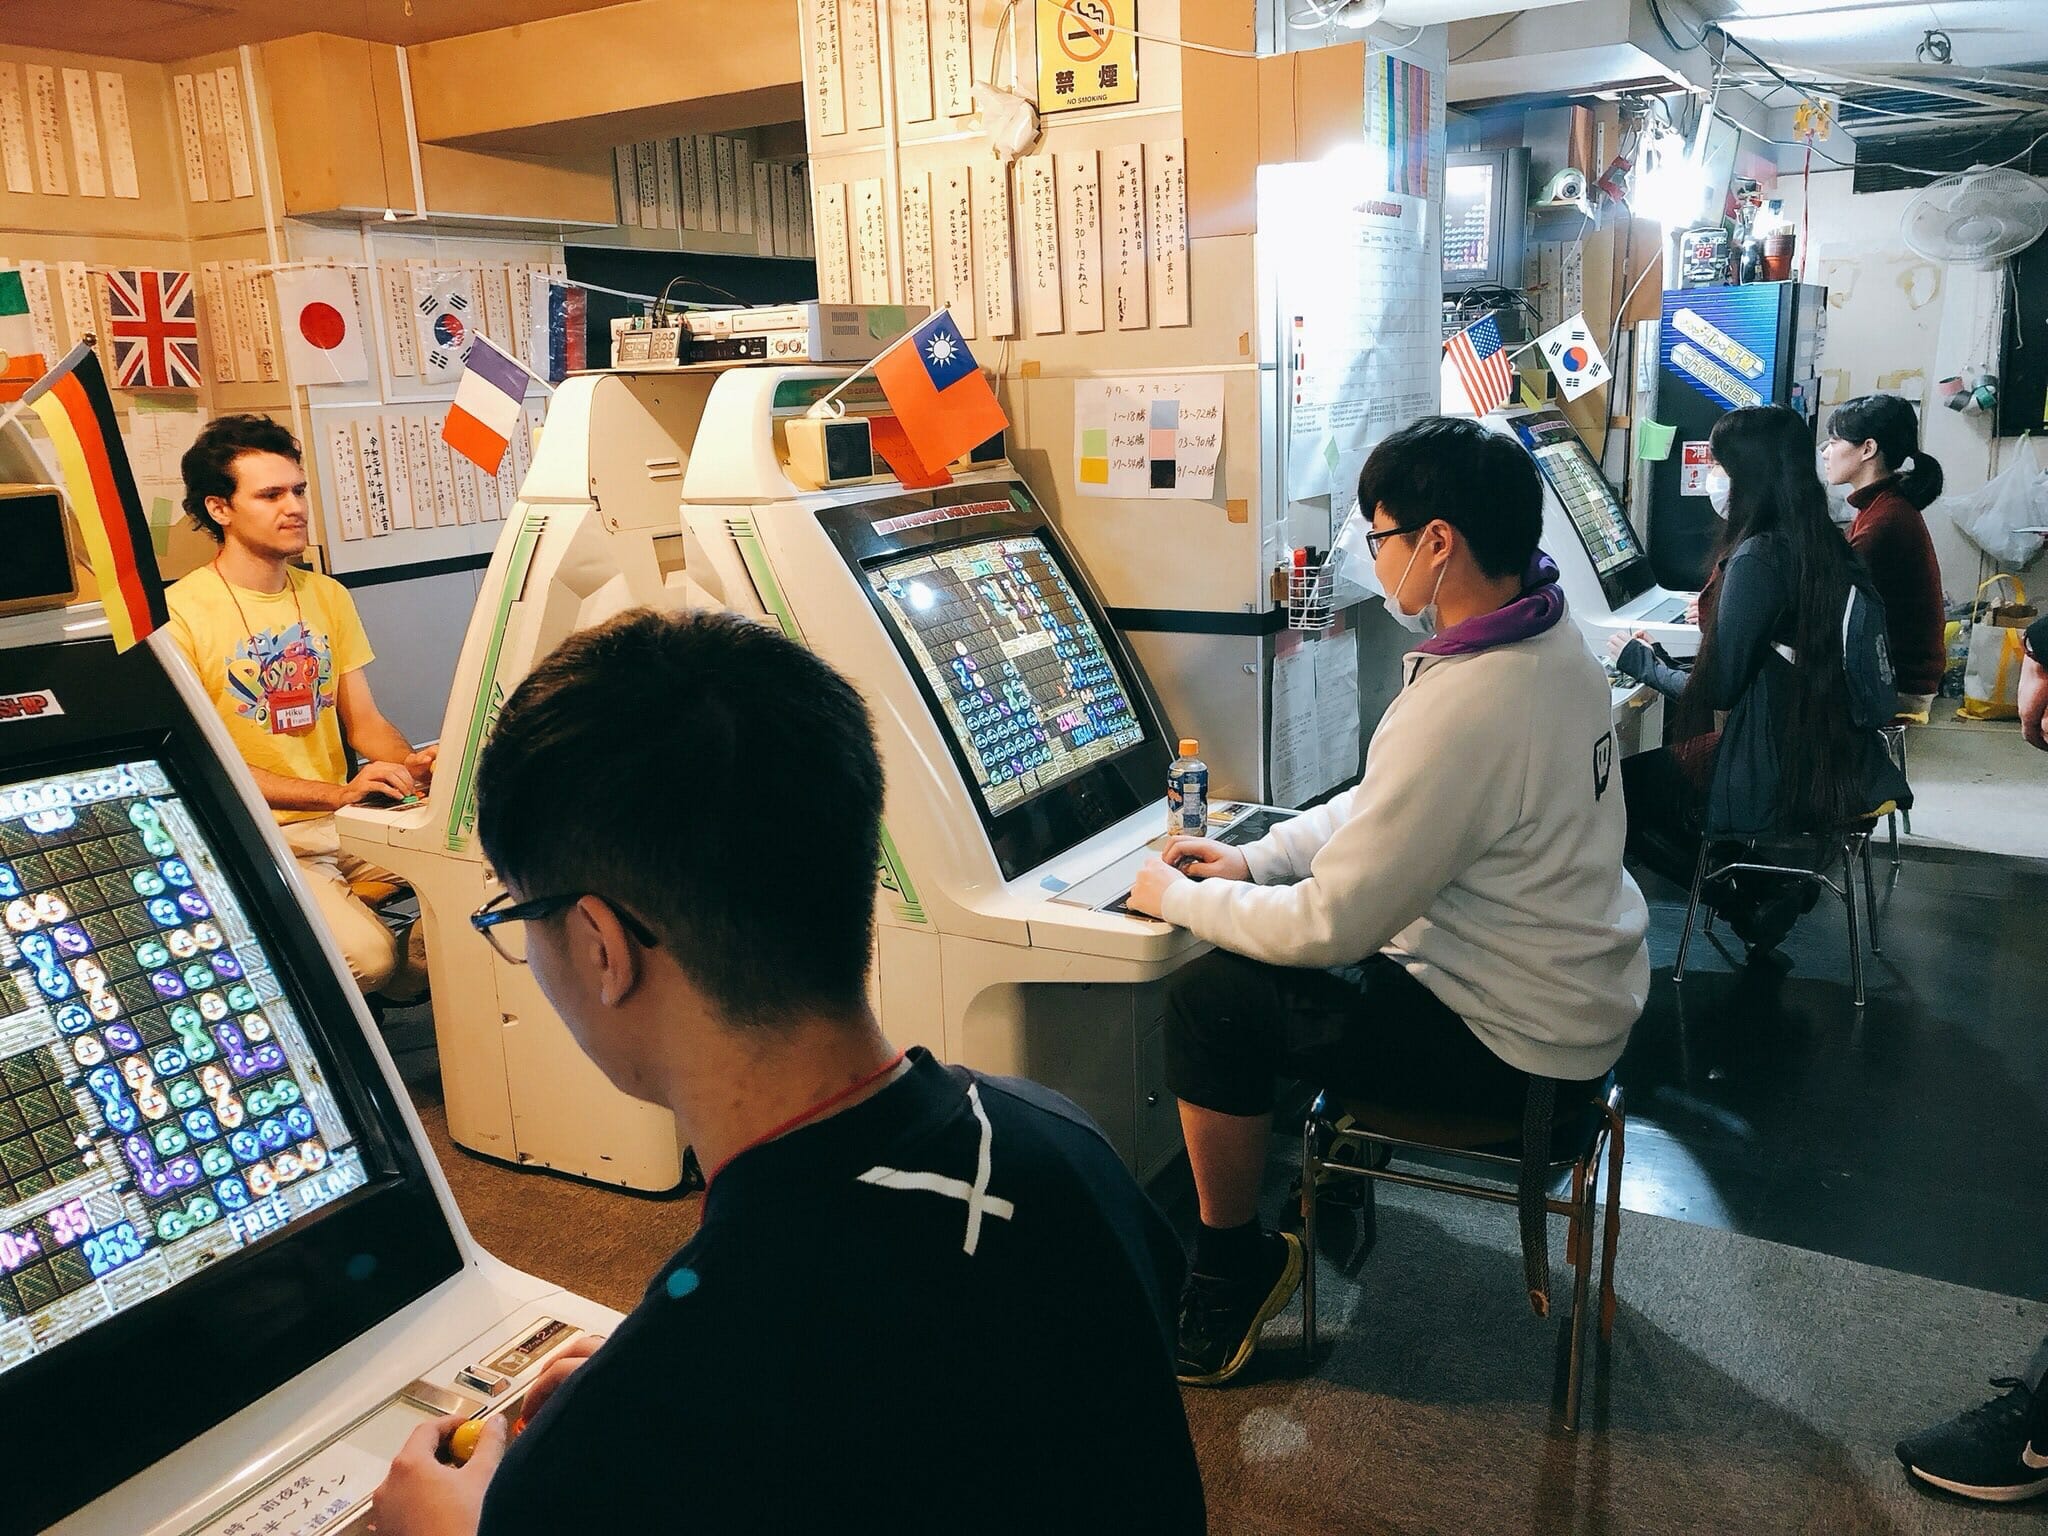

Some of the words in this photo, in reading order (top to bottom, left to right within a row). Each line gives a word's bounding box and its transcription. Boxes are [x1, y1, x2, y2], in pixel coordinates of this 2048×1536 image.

[1056, 64, 1118, 95] 禁煙
[1078, 94, 1108, 104] SMOKING
[1682, 350, 1755, 407] CHANGER
[285, 708, 303, 717] Hiku
[292, 716, 310, 726] France
[48, 1200, 90, 1246] 35
[229, 1198, 291, 1243] FREE
[83, 1223, 142, 1276] 253
